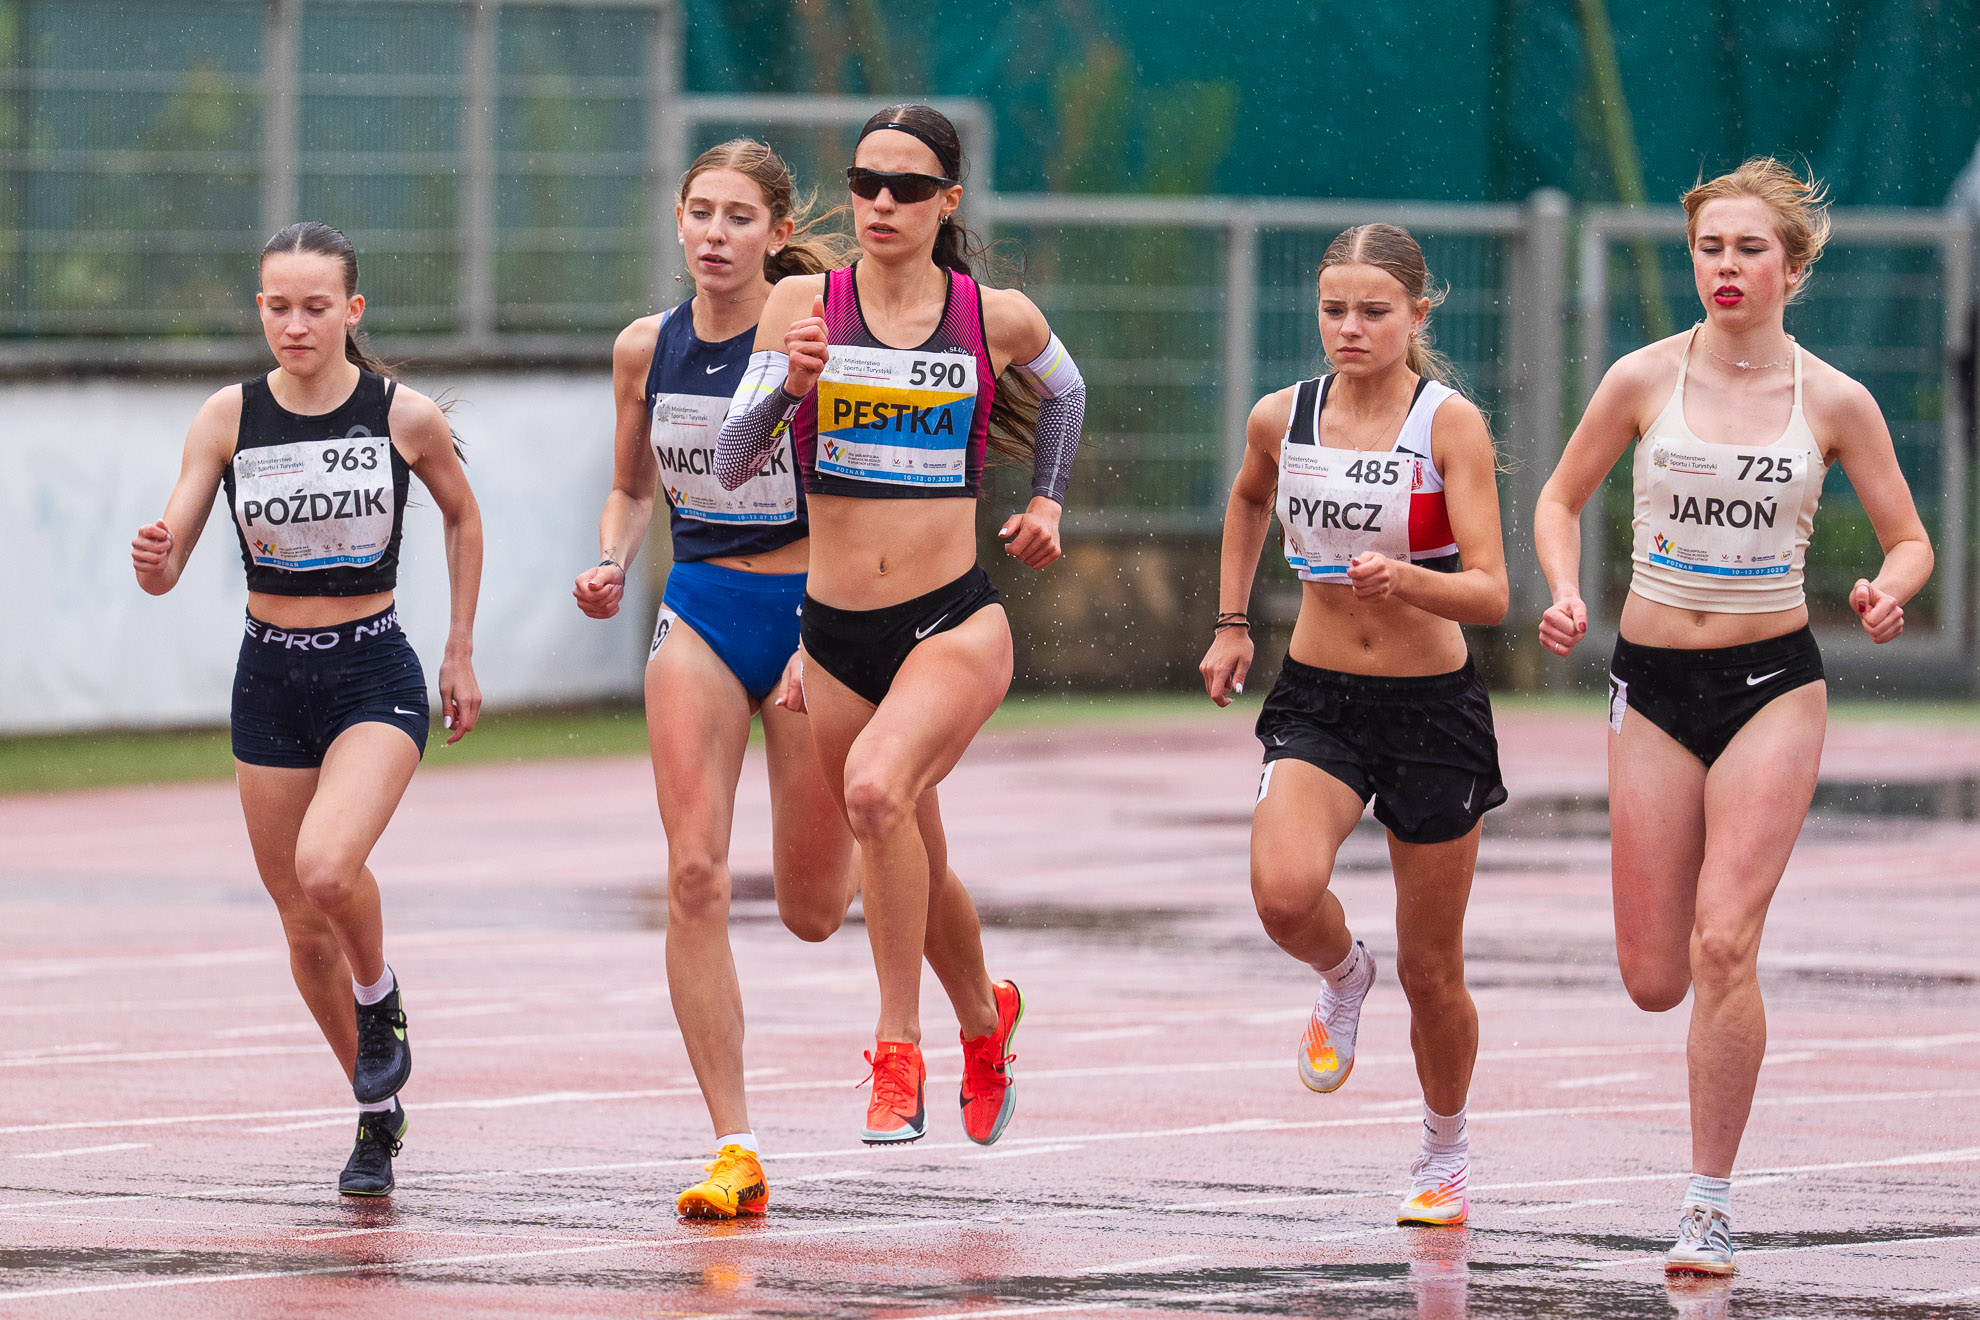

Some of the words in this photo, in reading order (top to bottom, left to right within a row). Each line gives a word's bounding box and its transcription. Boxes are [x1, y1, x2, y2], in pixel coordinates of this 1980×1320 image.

[844, 358, 881, 366] Ministerstwo
[909, 360, 966, 389] 590
[834, 398, 954, 436] PESTKA
[257, 456, 292, 466] Ministerstwo
[322, 446, 378, 473] 963
[1670, 452, 1706, 462] Ministerstwo
[1670, 460, 1688, 468] Sportu
[1692, 462, 1718, 470] Turystyki
[1737, 455, 1792, 483] 725
[836, 466, 865, 476] POZNAŃ
[1345, 459, 1400, 486] 485
[244, 487, 387, 527] POŹDZIK
[1289, 496, 1383, 532] PYRCZ
[1670, 494, 1778, 530] JAROŃ
[262, 629, 340, 651] PRO
[736, 1178, 766, 1204] NITRO
